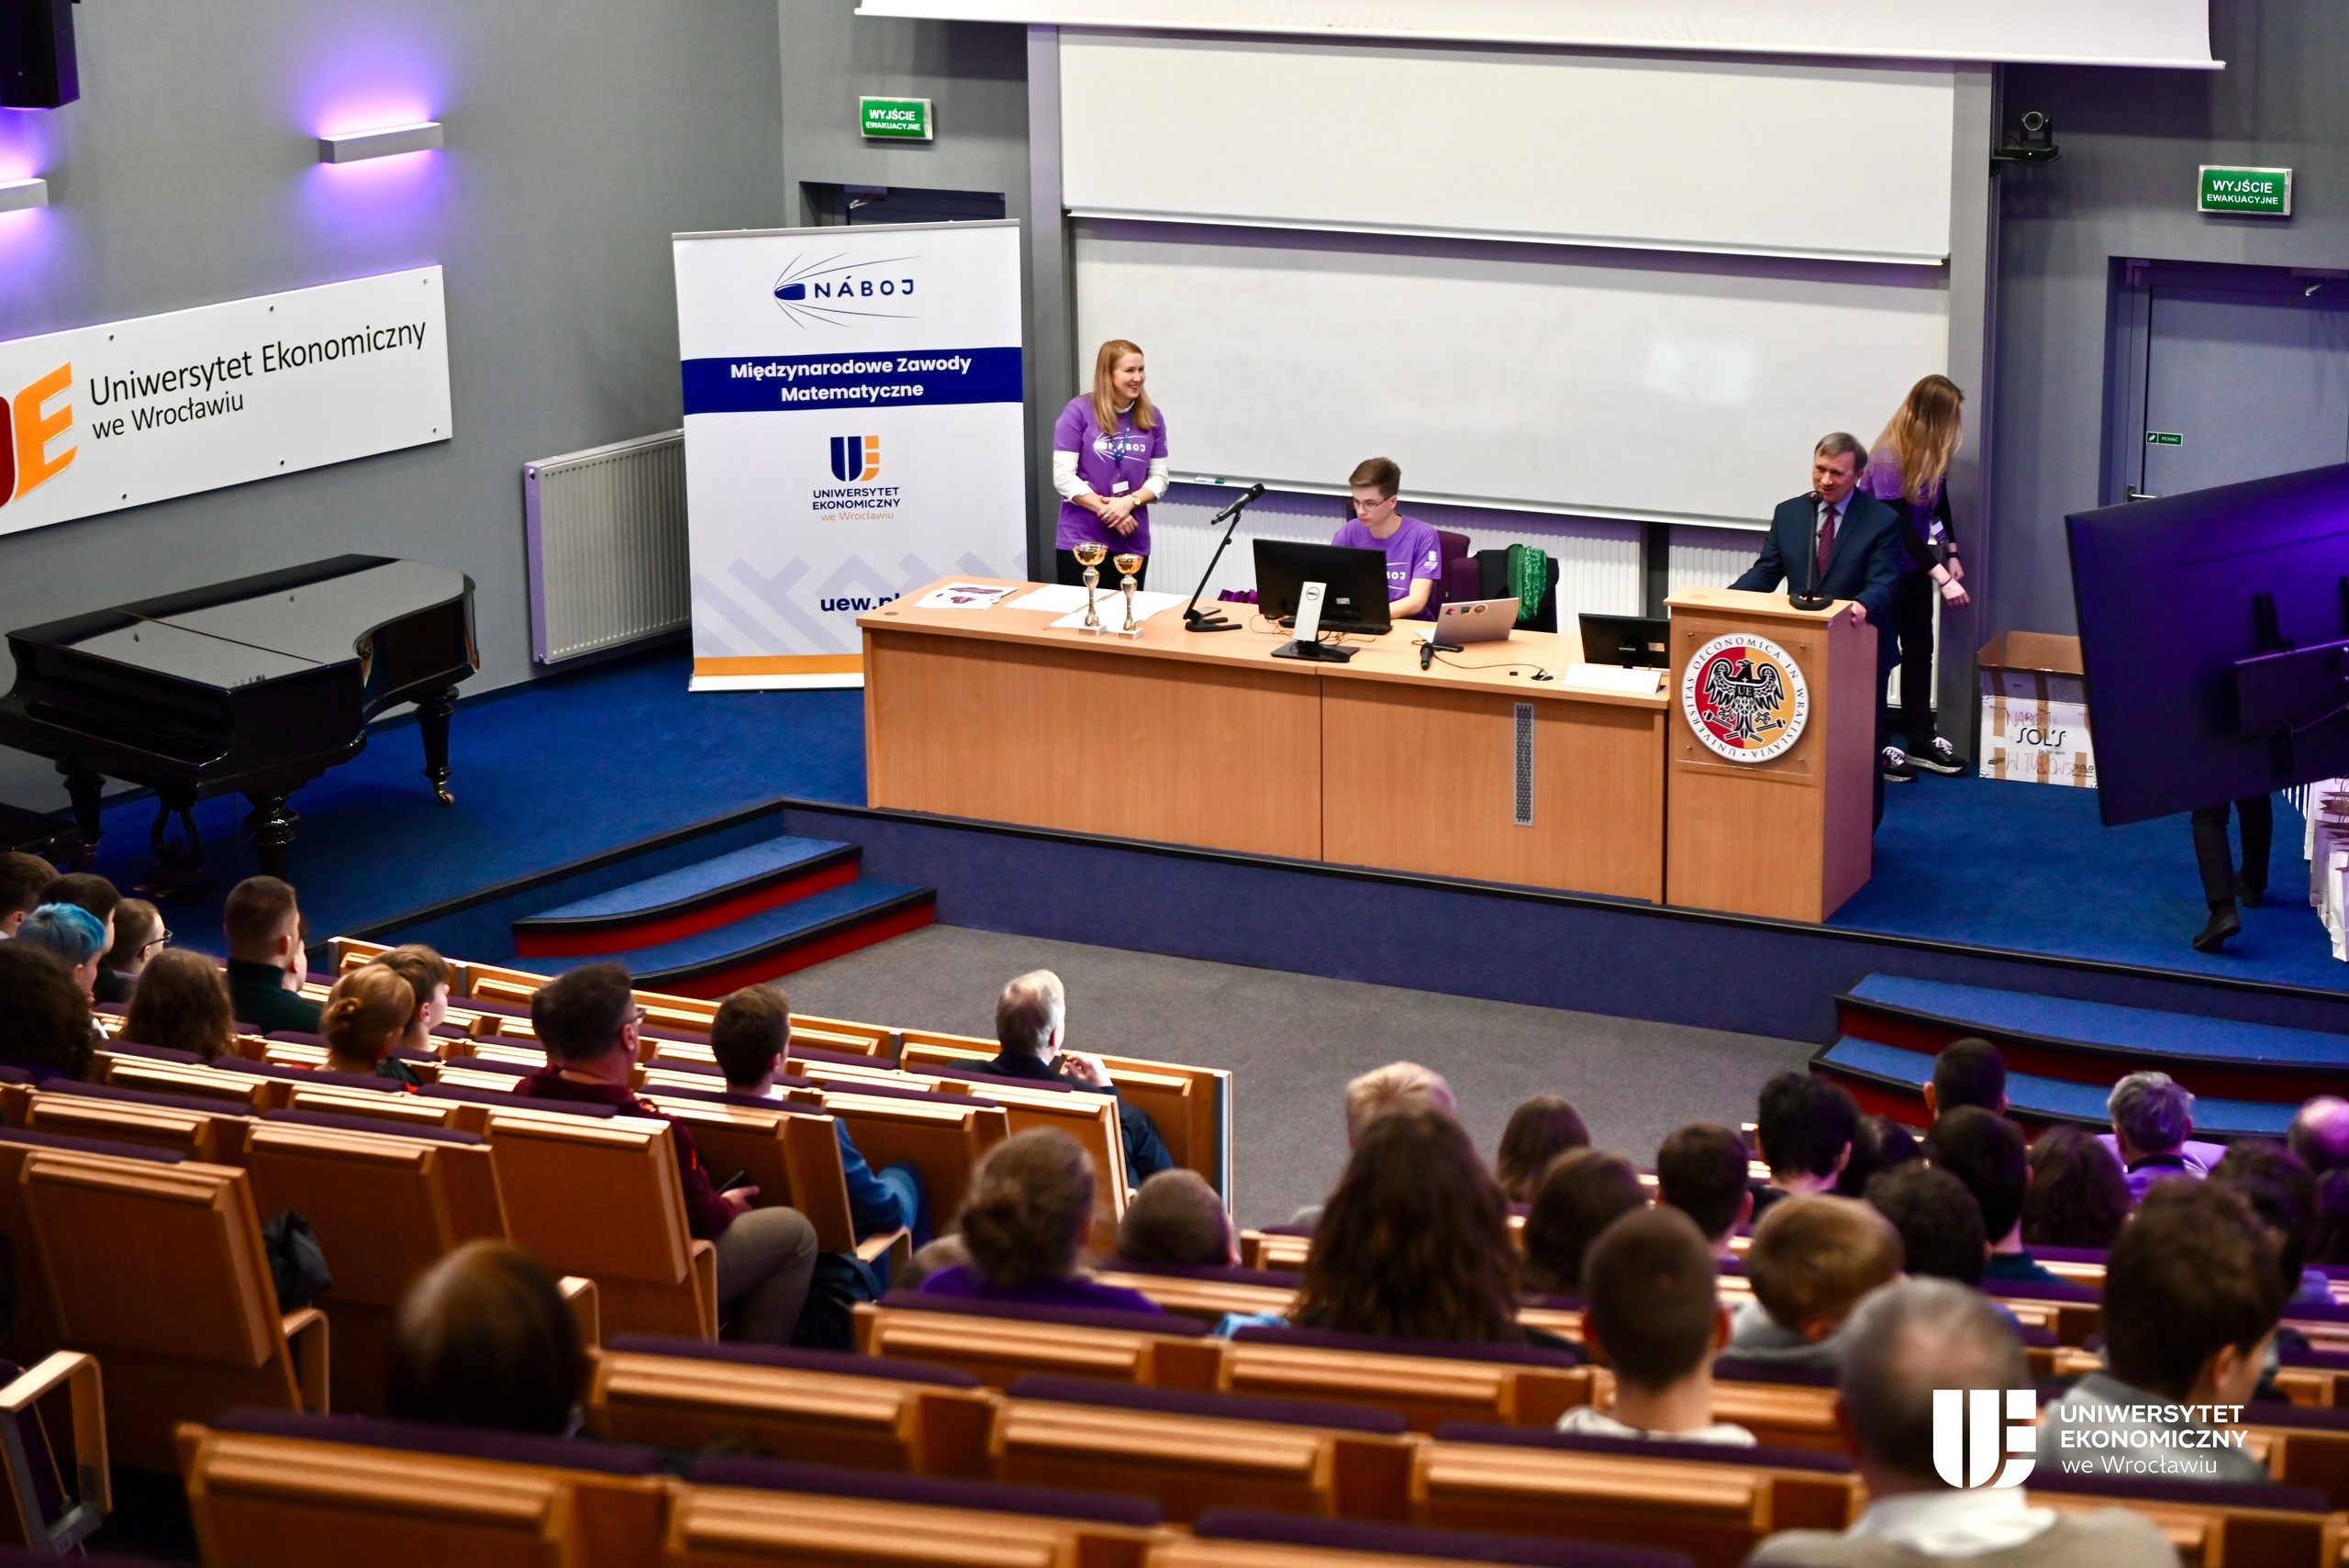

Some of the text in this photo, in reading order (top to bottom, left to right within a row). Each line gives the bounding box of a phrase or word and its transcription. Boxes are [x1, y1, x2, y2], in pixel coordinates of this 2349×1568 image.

[869, 108, 916, 121] WYJŚCIE
[865, 121, 921, 130] EWAKUACYJNE
[2212, 179, 2273, 193] WYJŚCIE
[2207, 194, 2278, 205] EWAKUACYJNE
[815, 275, 914, 298] NÁBOJ
[91, 322, 427, 406] Uniwersytet Ekonomiczny
[731, 355, 972, 382] Międzynarodowe Zawody
[782, 384, 924, 403] Matematyczne
[93, 392, 244, 439] we Wrocławiu
[813, 487, 899, 498] UNIWERSYTET
[812, 498, 901, 510] EKONOMICZNY
[840, 510, 894, 521] Wrocławiu
[1686, 637, 1806, 758] UNIVERSITAS OECONOMICA IN WRATISLAVIA
